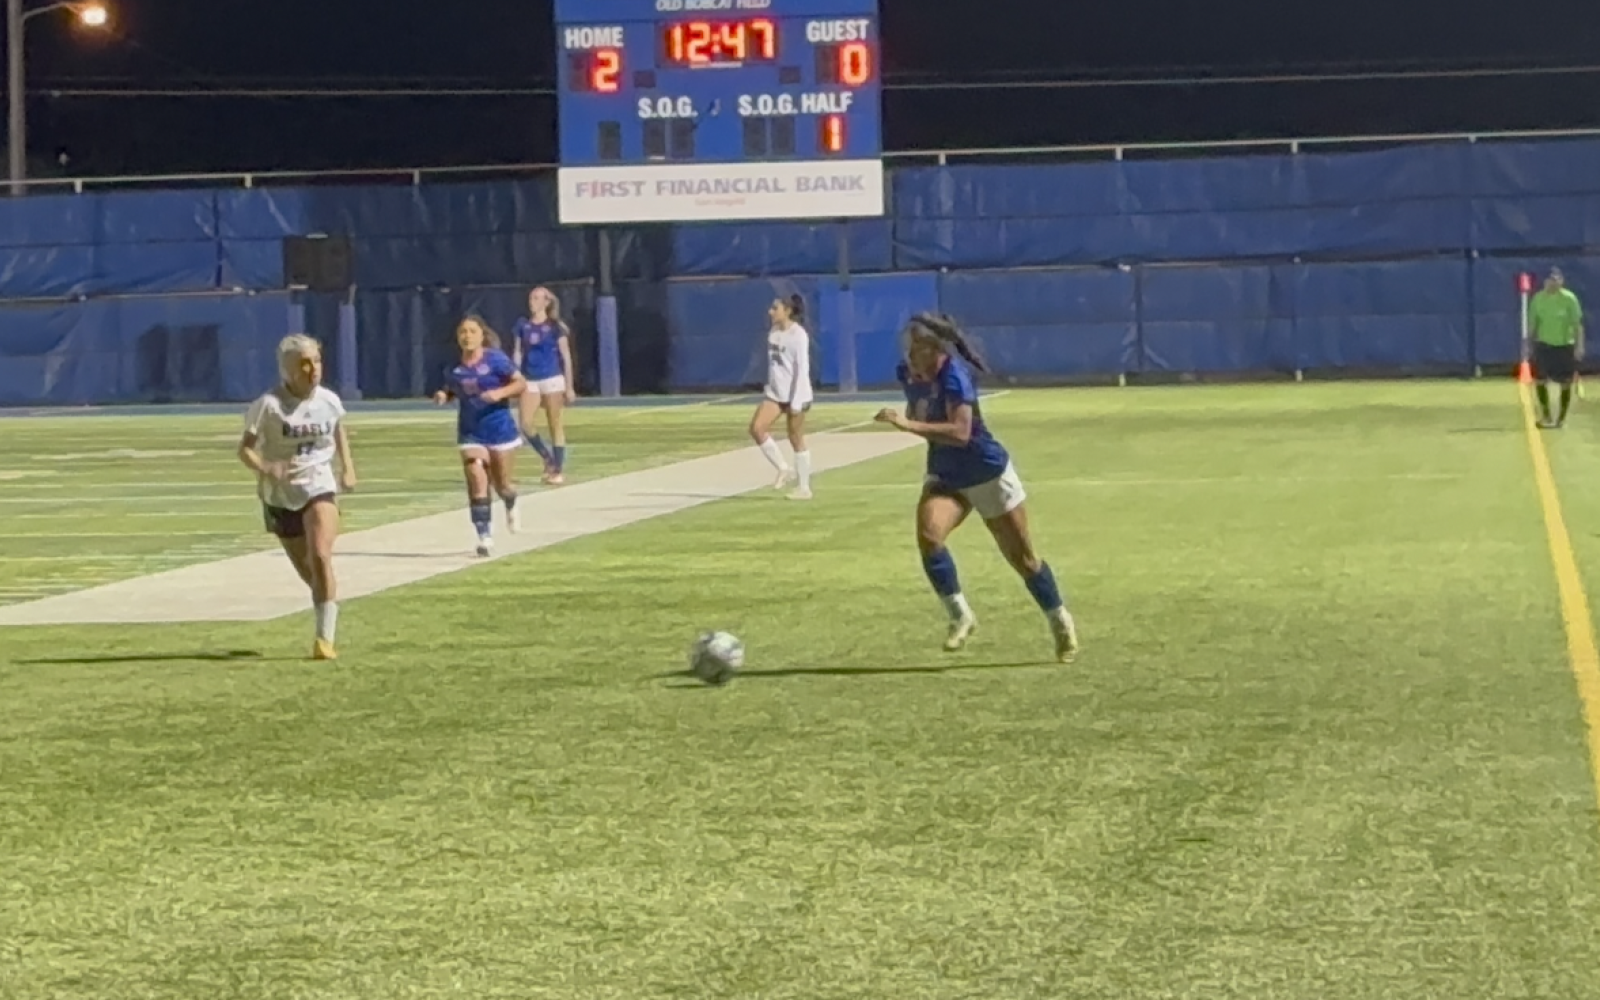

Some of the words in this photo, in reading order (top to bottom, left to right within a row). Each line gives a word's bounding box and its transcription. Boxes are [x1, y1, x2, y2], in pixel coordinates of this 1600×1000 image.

[565, 27, 624, 48] HOME
[668, 19, 774, 61] 12:47
[806, 20, 869, 42] GUEST
[592, 51, 619, 91] 2
[840, 43, 869, 84] 0
[638, 95, 698, 119] S.O.G.
[738, 94, 798, 116] S.O.G.
[801, 91, 853, 113] HALF
[829, 115, 842, 151] 1
[575, 180, 646, 198] FIRST
[656, 177, 785, 196] FINANCIAL
[796, 174, 866, 193] BANK
